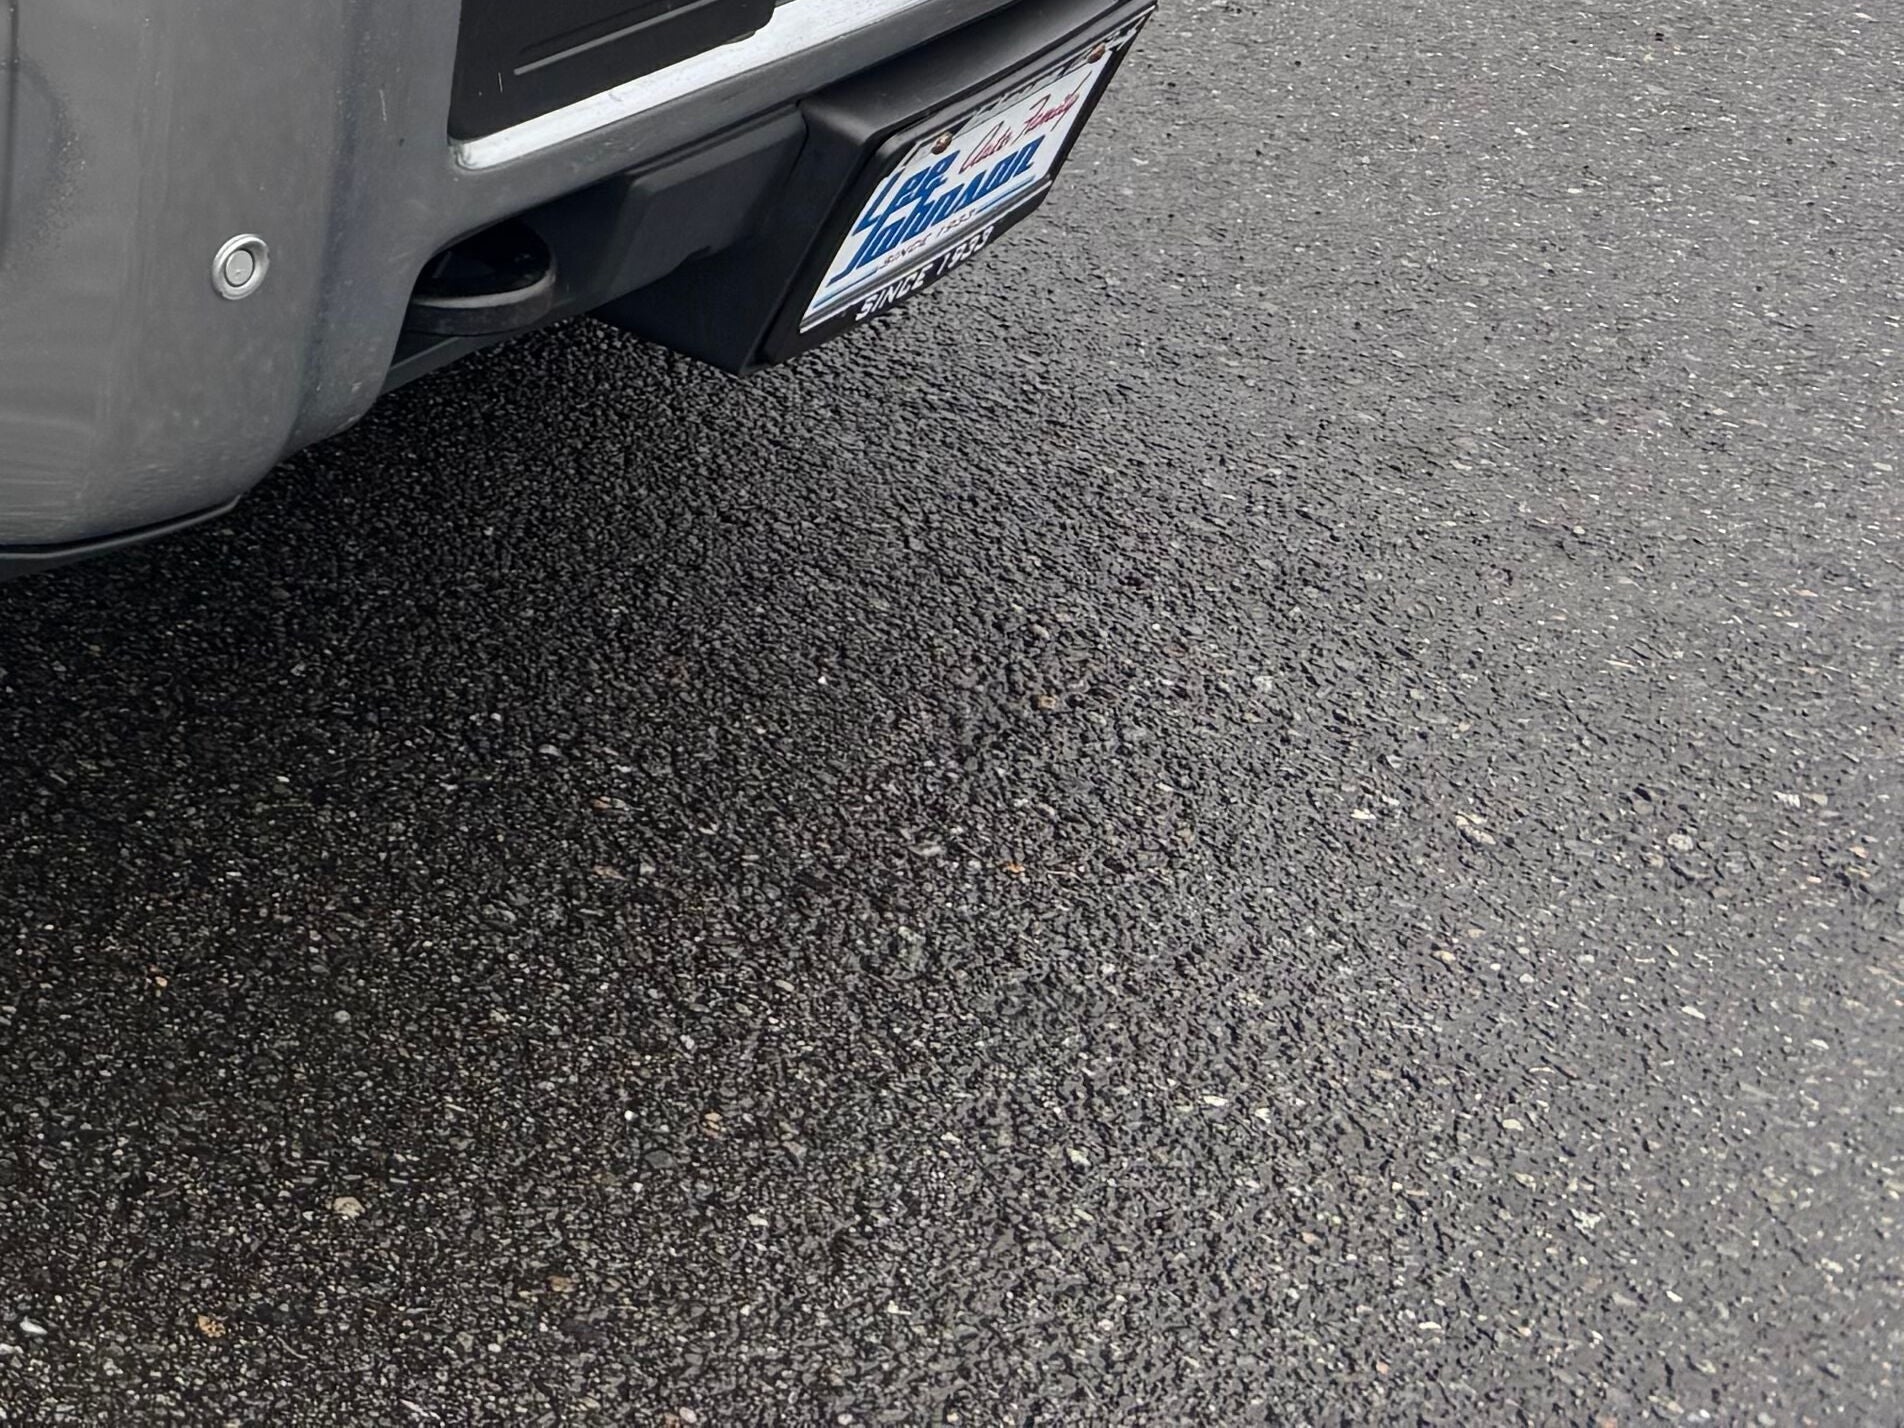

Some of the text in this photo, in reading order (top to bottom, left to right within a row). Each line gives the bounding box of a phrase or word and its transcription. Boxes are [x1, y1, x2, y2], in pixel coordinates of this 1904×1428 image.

[825, 134, 1046, 287] Johnson
[851, 148, 961, 237] Lee
[855, 224, 995, 321] SINCE 1933
